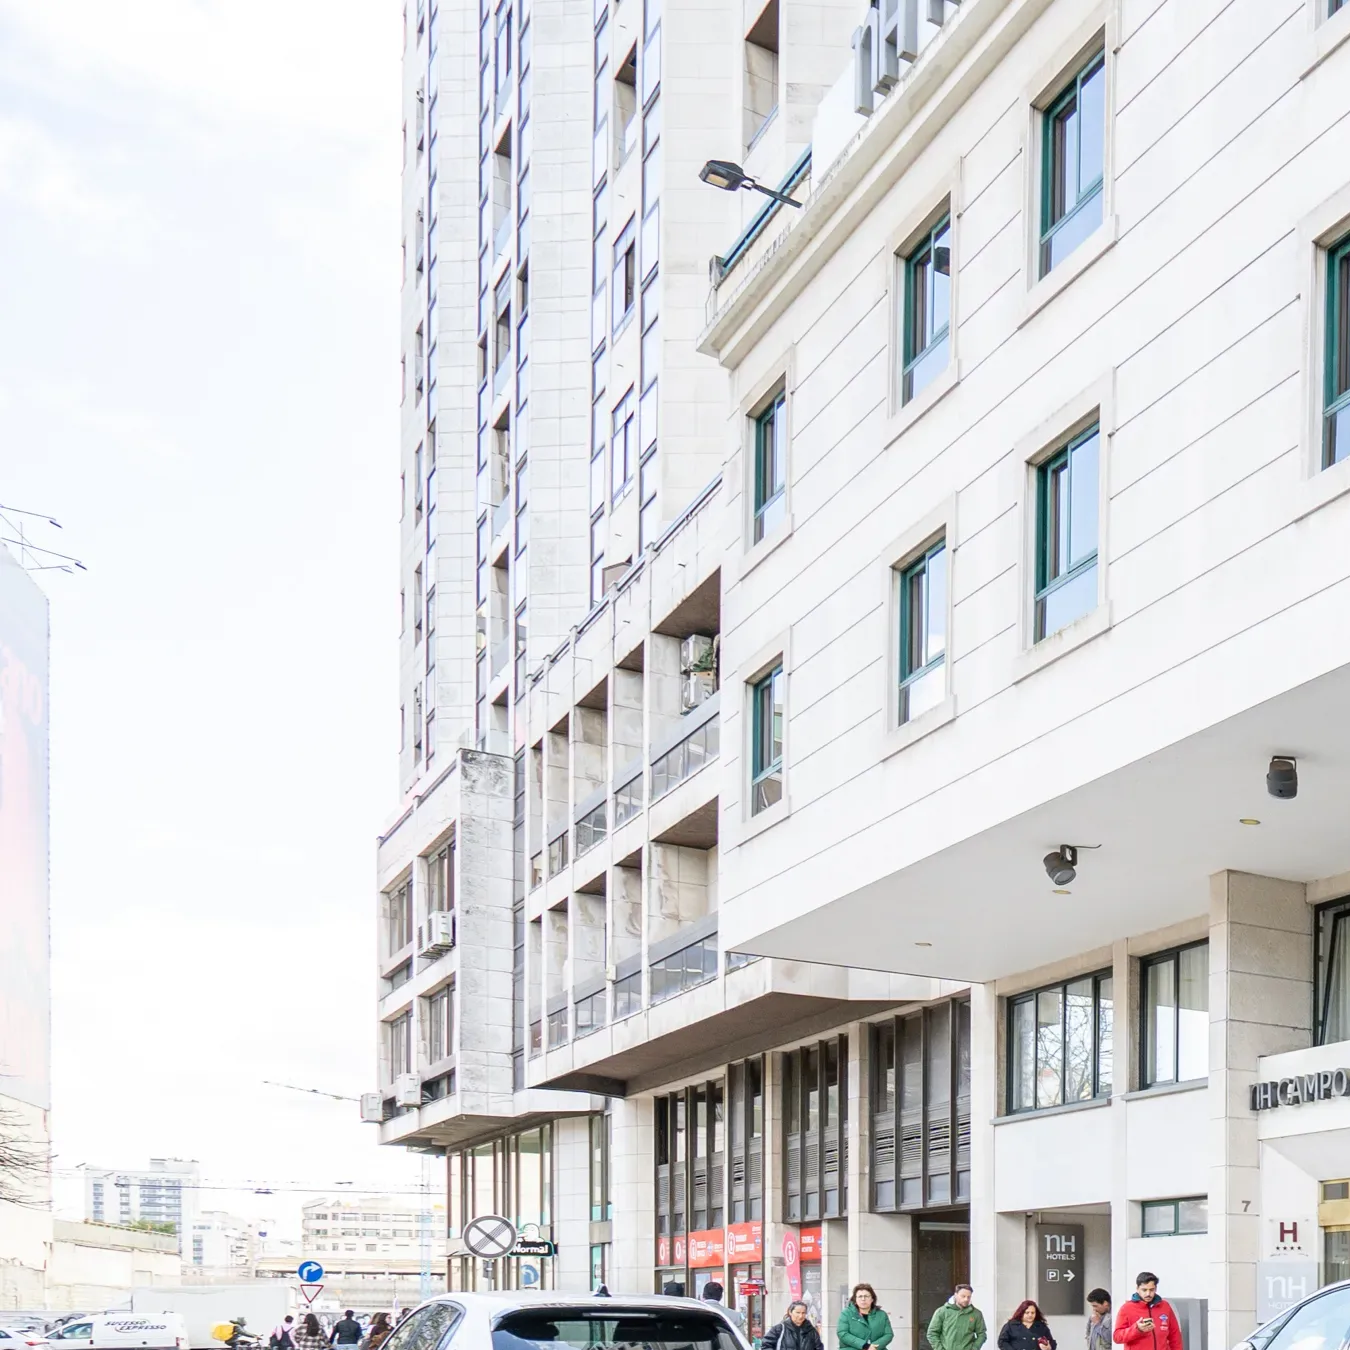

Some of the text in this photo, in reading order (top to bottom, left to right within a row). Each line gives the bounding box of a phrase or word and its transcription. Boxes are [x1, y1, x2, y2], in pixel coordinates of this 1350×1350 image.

[1241, 1200, 1252, 1213] 7
[1279, 1221, 1298, 1243] H
[512, 1243, 549, 1254] Normal
[1046, 1253, 1076, 1261] HOTELS
